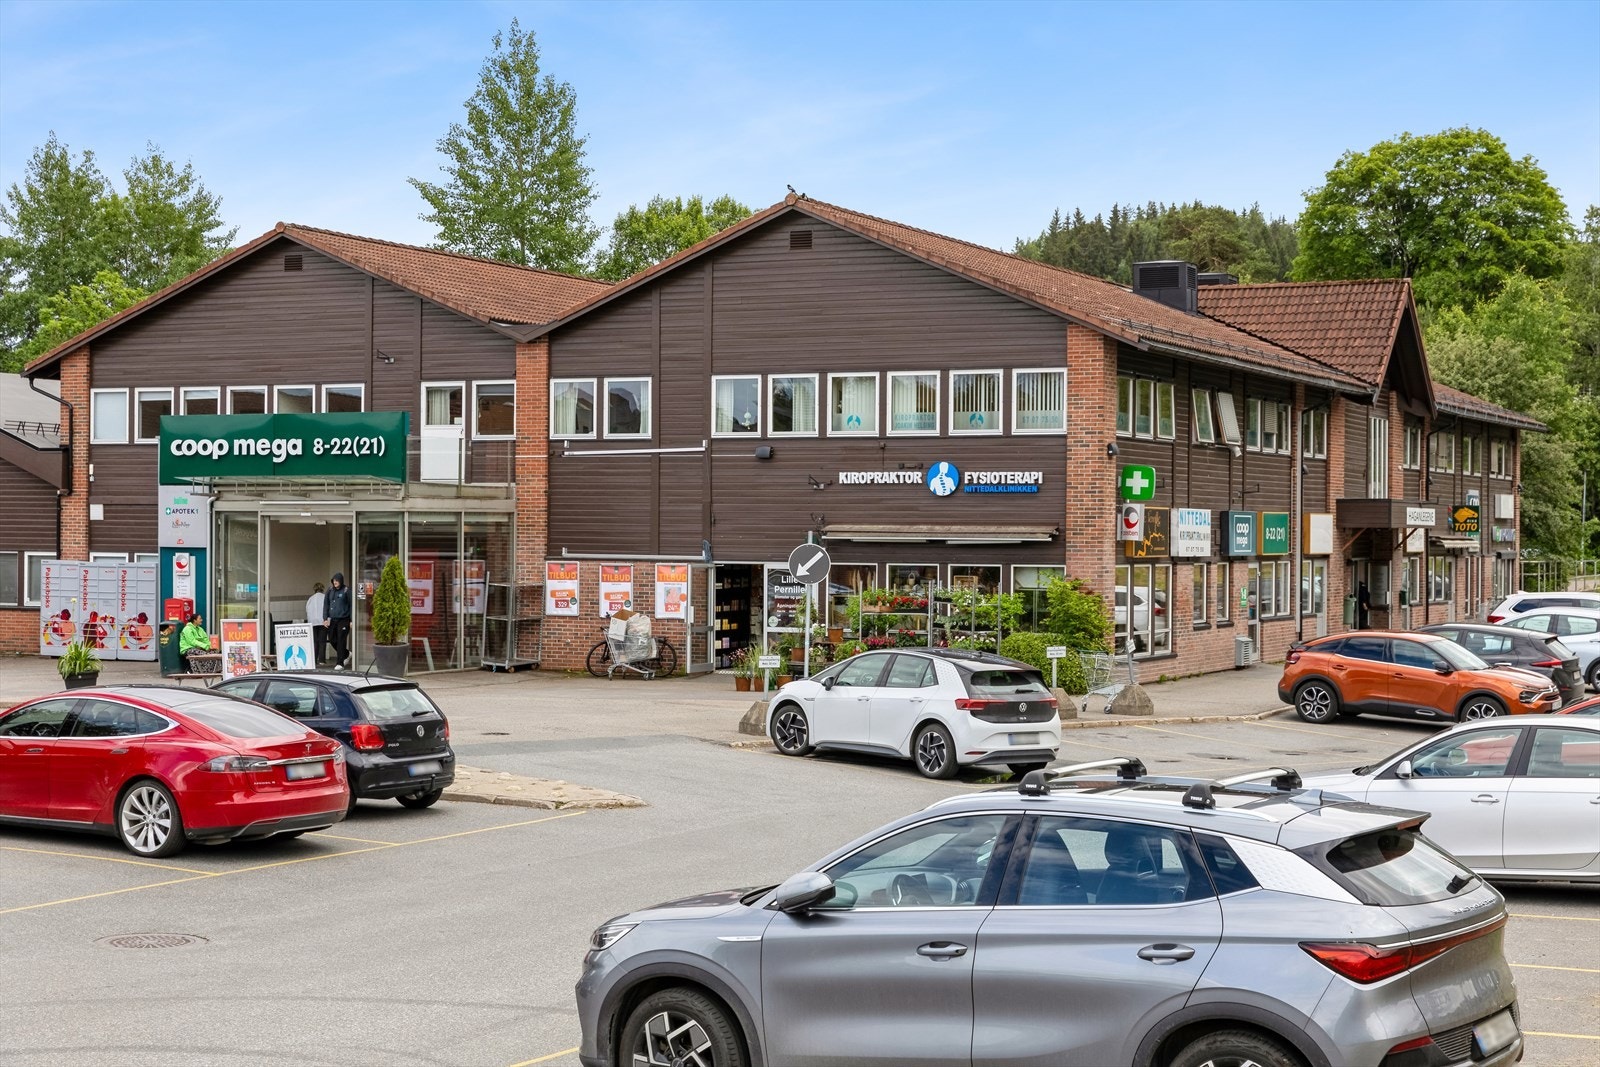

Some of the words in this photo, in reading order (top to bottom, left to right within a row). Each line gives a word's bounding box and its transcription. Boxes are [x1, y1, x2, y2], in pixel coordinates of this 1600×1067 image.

[170, 438, 230, 460] coop
[233, 438, 303, 463] mega
[838, 471, 923, 485] KIROPRAKTOR
[964, 471, 1043, 485] FYSIOTERAPI
[964, 485, 1038, 493] NITTEDALKLINIKKEN
[1179, 510, 1211, 526] NITTEDAL
[1236, 523, 1249, 535] coop
[1455, 523, 1478, 531] TOTO
[1265, 527, 1276, 540] 8-22
[1276, 527, 1286, 541] (21)
[1236, 536, 1248, 547] mega
[549, 571, 578, 579] TILBUD
[602, 573, 630, 581] TILBUD
[658, 572, 688, 581] TILBUD
[774, 585, 806, 594] Pernille
[228, 631, 253, 641] KUPP
[279, 628, 308, 636] NITTEDAL
